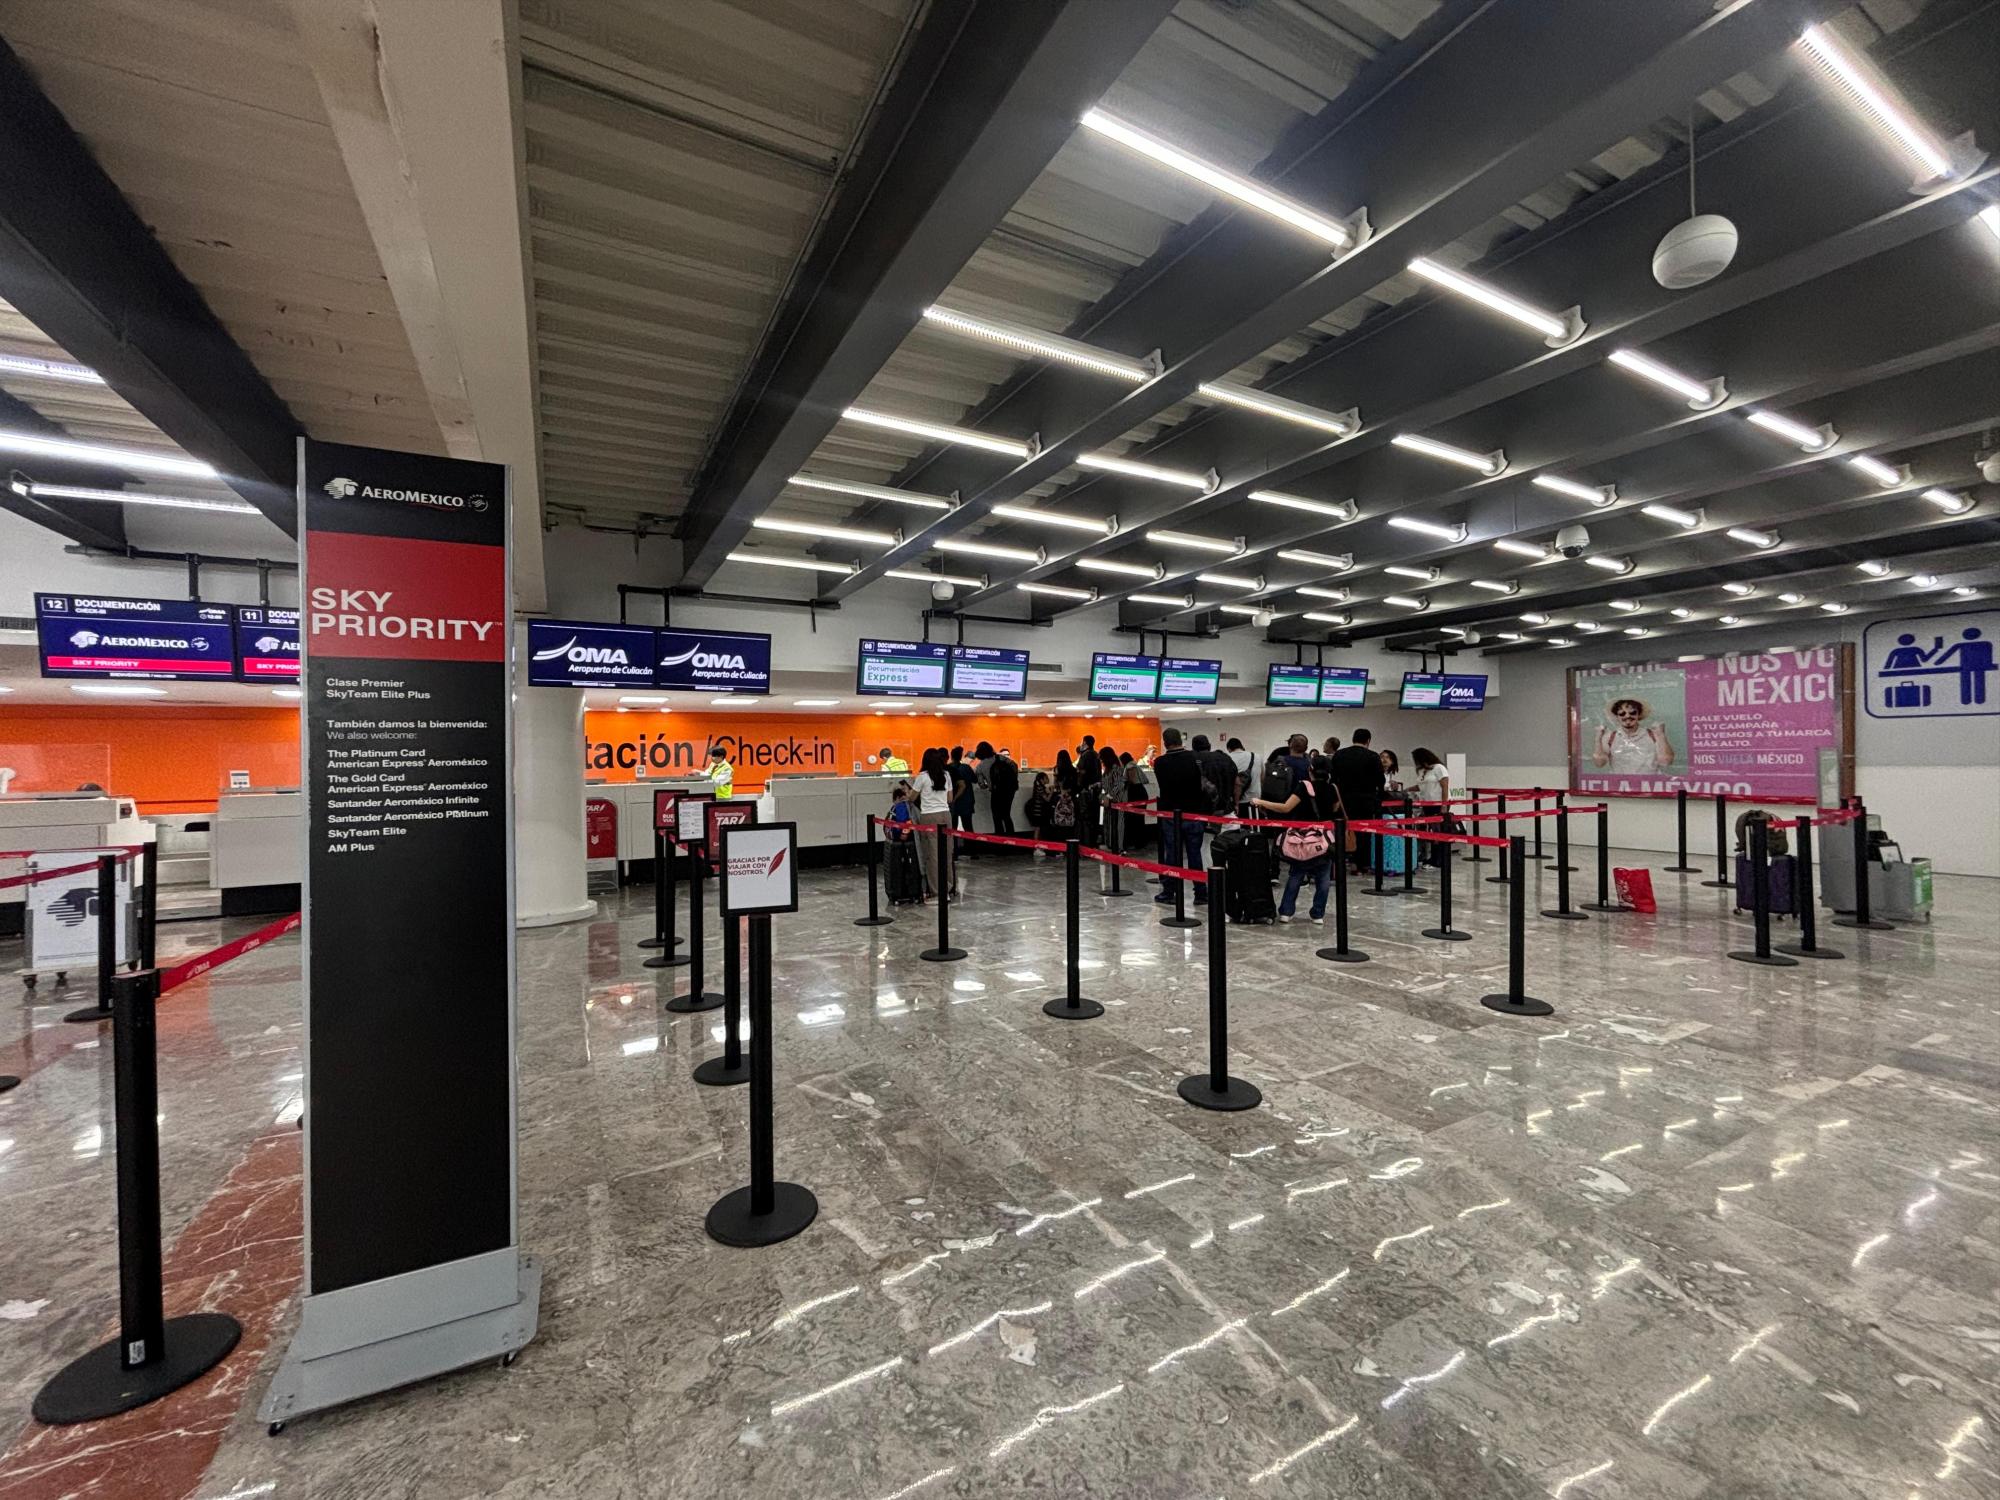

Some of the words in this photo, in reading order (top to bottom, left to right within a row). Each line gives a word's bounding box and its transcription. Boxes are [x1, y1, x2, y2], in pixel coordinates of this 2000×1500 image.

[47, 600, 63, 609] 12
[311, 587, 393, 612] SKY
[74, 599, 161, 611] DOCUMENTACIÓN
[244, 611, 257, 620] 11
[311, 612, 494, 641] PRIORITY
[567, 646, 628, 664] OMA
[691, 652, 746, 670] OMA
[568, 664, 612, 675] Aeropuerto
[612, 666, 621, 674] de
[621, 665, 653, 676] Culiacán
[692, 669, 730, 680] Aeropuerto
[730, 671, 739, 679] de
[739, 670, 767, 680] Culiacán
[326, 678, 358, 687] Clase
[361, 678, 405, 688] Premier
[867, 673, 908, 683] Express
[1097, 681, 1129, 691] General
[326, 690, 378, 699] SkyTeam
[381, 690, 405, 699] Elite
[408, 691, 431, 699] Plus
[1450, 688, 1474, 697] OMA
[1692, 714, 1722, 722] DALE
[1723, 713, 1762, 721] VUELO
[326, 720, 375, 729] También
[378, 720, 415, 729] damos
[417, 720, 427, 729] la
[430, 720, 488, 729] bienvenida:
[1692, 723, 1701, 731] A
[1719, 720, 1779, 730] CAMPAÑA
[326, 731, 345, 740] We
[347, 731, 368, 740] also
[370, 731, 417, 740] welcome:
[1692, 731, 1753, 739] LLEVEMOS
[1767, 730, 1782, 738] TU
[1784, 729, 1832, 737] MARCA
[1693, 739, 1719, 747] MÁS
[327, 750, 349, 758] The
[351, 749, 398, 758] Platinum
[400, 748, 426, 757] Card
[1693, 753, 1716, 765] NOS
[1757, 751, 1804, 765] MÉXICO
[327, 760, 380, 769] American
[428, 758, 488, 767] Aeroméxico
[327, 774, 349, 783] The
[351, 774, 377, 783] Gold
[379, 773, 405, 782] Card
[327, 785, 380, 794] American
[428, 782, 488, 791] Aeroméxico
[327, 799, 382, 809] Santander
[384, 797, 443, 807] Aeroméxico
[445, 796, 480, 805] Infinite
[327, 814, 382, 824] Santander
[384, 811, 444, 821] Aeroméxico
[446, 810, 489, 819] Platinum
[715, 816, 738, 826] TAR
[327, 829, 380, 839] SkyTeam
[382, 827, 407, 836] Elite
[327, 844, 347, 853] AM
[350, 843, 375, 852] Plus
[727, 856, 756, 864] GRACIAS
